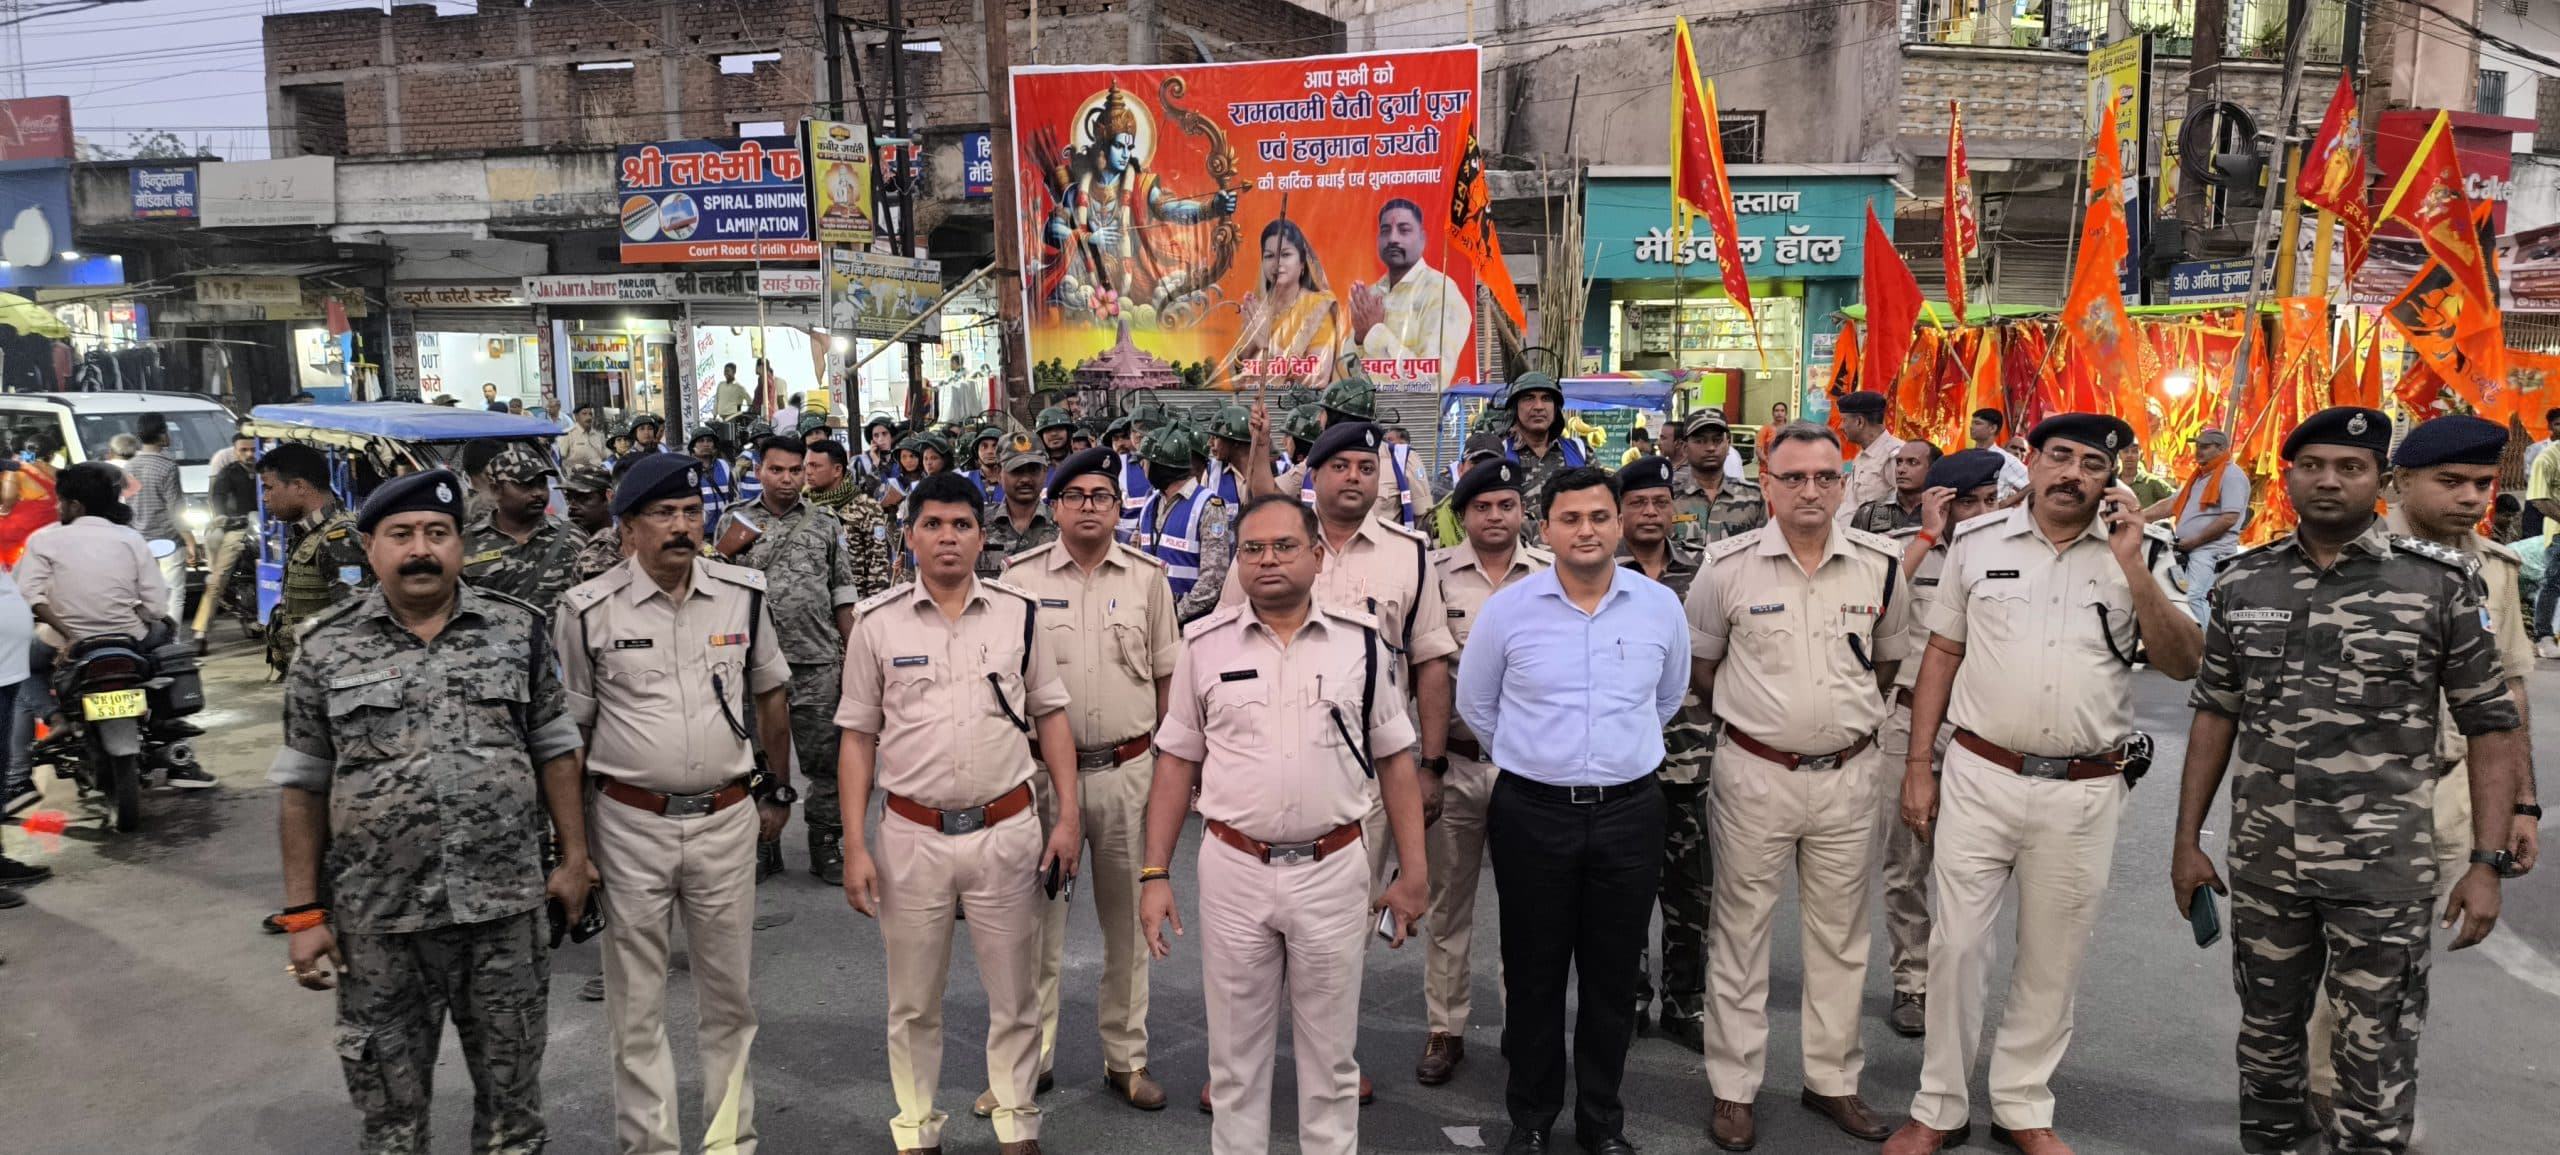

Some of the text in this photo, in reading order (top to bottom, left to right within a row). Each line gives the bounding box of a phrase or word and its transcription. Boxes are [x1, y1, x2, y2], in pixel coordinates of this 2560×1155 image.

[1304, 61, 1394, 89] आप सभी को
[1228, 88, 1471, 127] रामनवमी चैती दुर्गा पूजा
[1258, 125, 1440, 165] एवं हनुमान जयंती
[621, 145, 663, 188] श्री
[667, 140, 764, 185] लक्ष्मी
[1257, 172, 1274, 190] की
[1278, 168, 1313, 190] हार्दिक
[1316, 167, 1345, 190] बधाई
[2467, 173, 2513, 201] Cake
[703, 194, 752, 211] SPIRAL
[716, 217, 799, 233] LAMINATION
[689, 245, 717, 257] Court
[721, 244, 748, 256] Road
[790, 242, 820, 256] (Jhar
[1774, 224, 1845, 264] हॉल
[537, 281, 553, 298] JAI
[618, 278, 659, 294] PARLOUR
[675, 271, 698, 295] श्री
[699, 270, 745, 296] लक्ष्मी
[762, 275, 793, 293] साई
[2192, 270, 2220, 289] अमित
[2222, 271, 2251, 291] कुमार
[436, 288, 472, 303] फोटो
[474, 287, 513, 303] स्टेट
[618, 290, 654, 300] SALOON
[421, 354, 439, 368] OUT
[1291, 354, 1321, 376] देवी
[1403, 358, 1440, 380] गुप्ता
[420, 374, 441, 393] फोटो
[1164, 538, 1187, 550] POLICE
